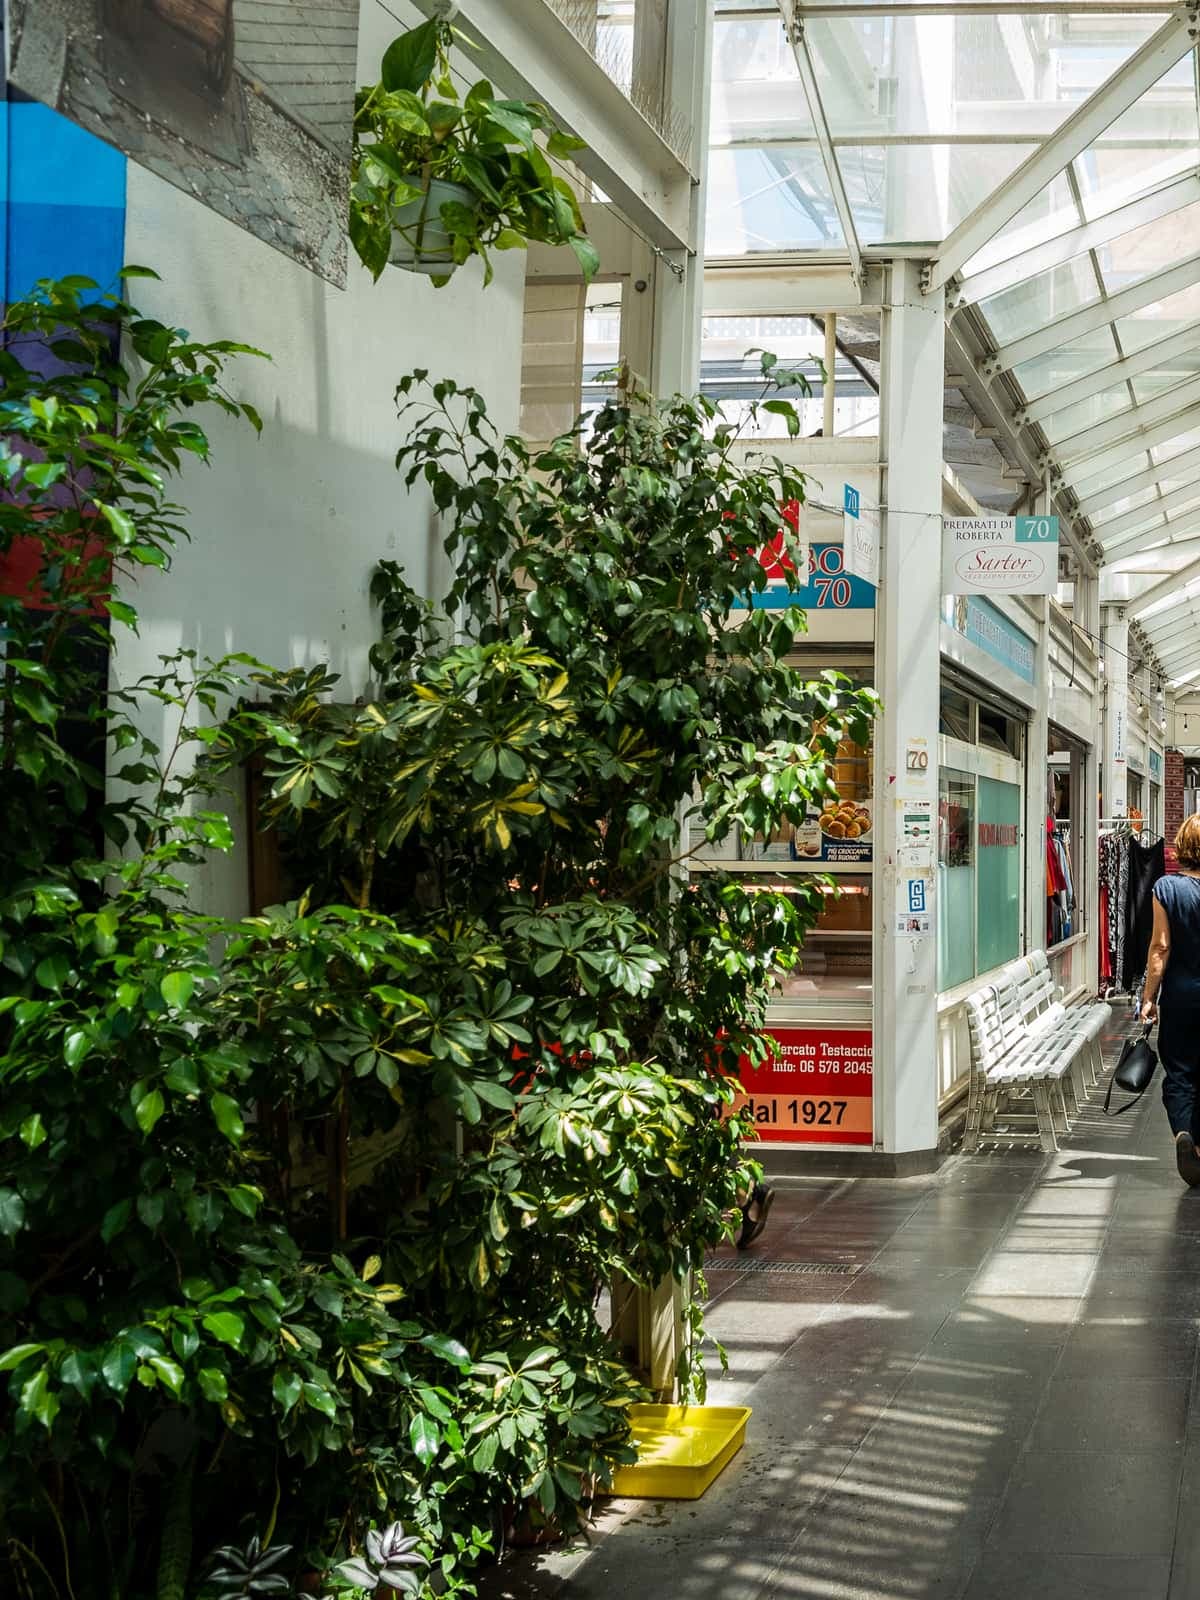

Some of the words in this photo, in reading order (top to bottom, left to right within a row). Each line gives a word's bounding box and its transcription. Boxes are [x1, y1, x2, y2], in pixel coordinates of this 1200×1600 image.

[943, 520, 997, 530] PREPARATI
[1000, 520, 1012, 529] DI
[1024, 519, 1050, 539] 70
[956, 532, 1003, 541] ROBERTA
[968, 550, 1032, 571] Sartor
[814, 577, 852, 608] 70
[910, 751, 929, 768] 70
[772, 1043, 816, 1056] ercato
[819, 1042, 873, 1057] Testaccio
[772, 1060, 797, 1073] info:
[799, 1060, 815, 1073] 06
[818, 1060, 840, 1074] 578
[843, 1061, 873, 1074] 2045
[740, 1099, 778, 1124] dal
[787, 1099, 848, 1126] 1927
